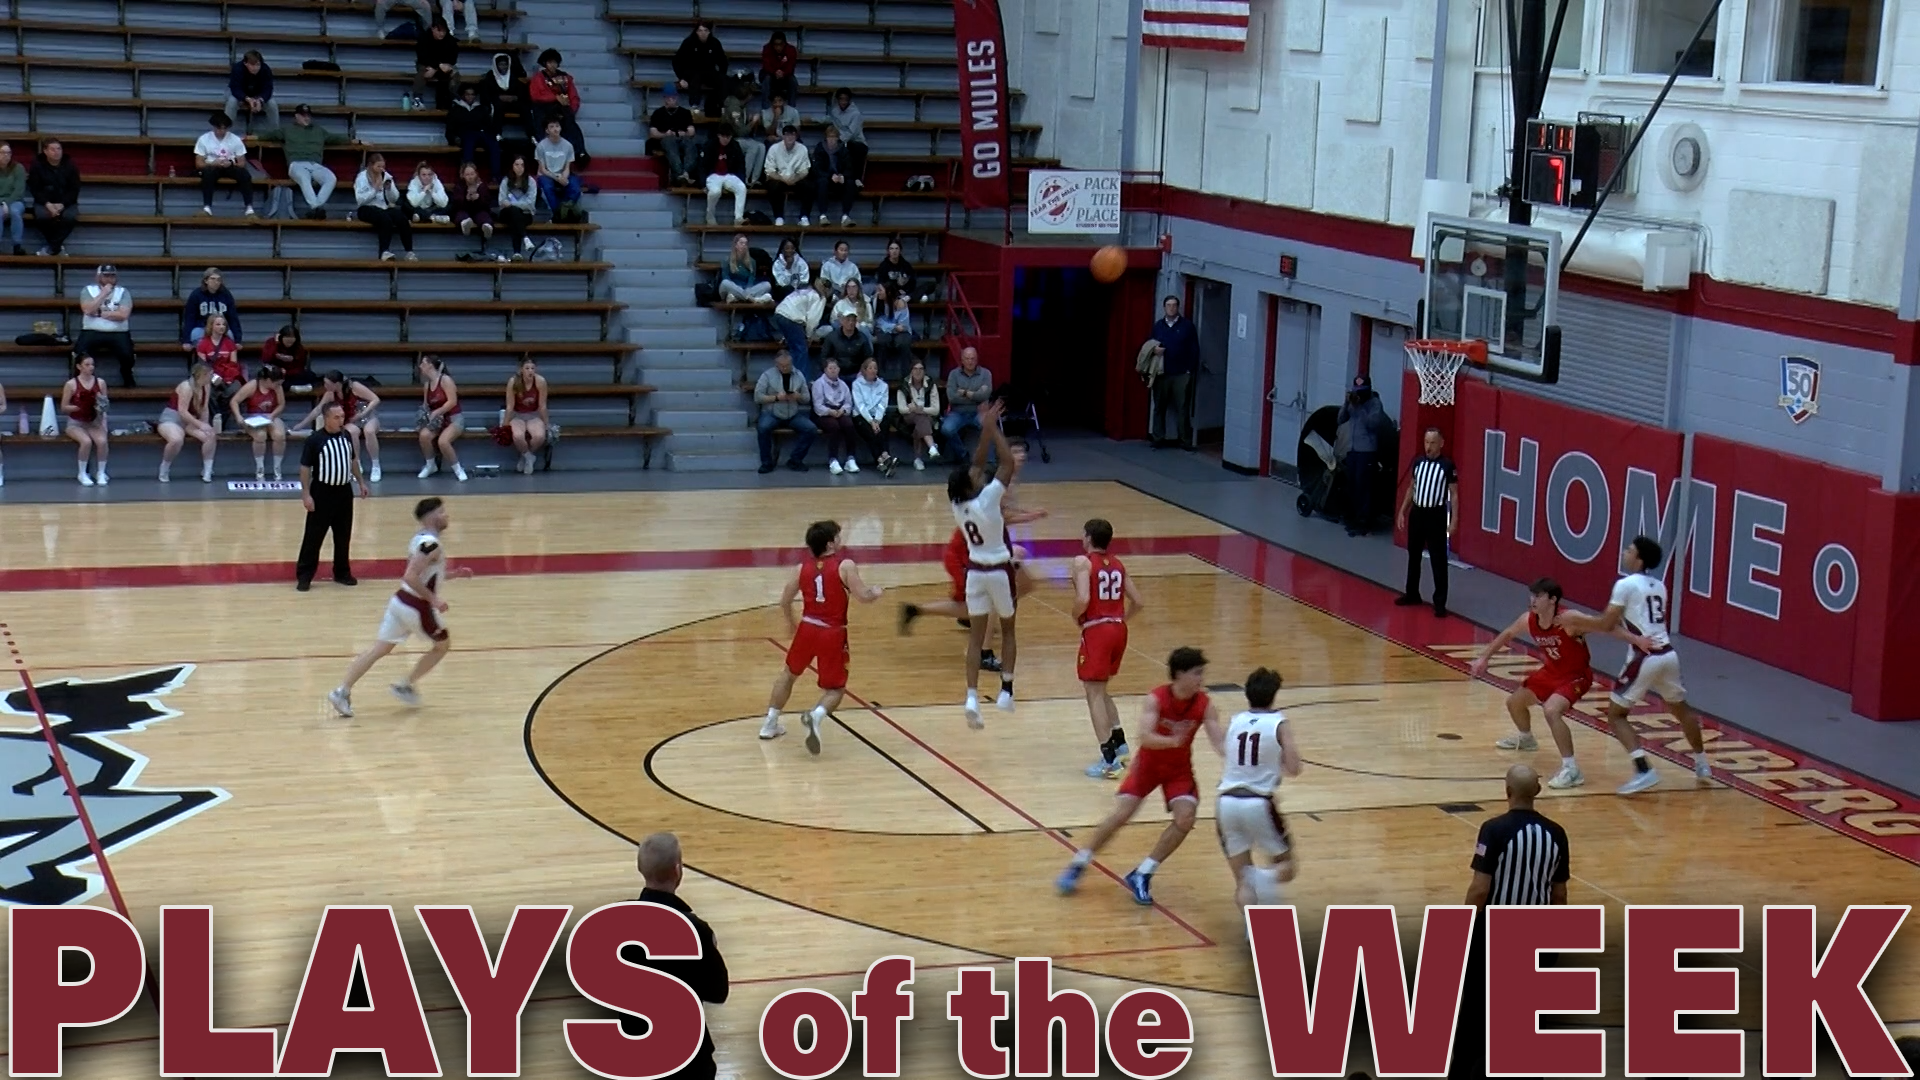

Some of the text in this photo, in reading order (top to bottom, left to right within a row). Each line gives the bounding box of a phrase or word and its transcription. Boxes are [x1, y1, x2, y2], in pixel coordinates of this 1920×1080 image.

[967, 39, 1001, 178] GO MULES
[1083, 177, 1119, 190] PACK
[1549, 158, 1564, 203] 7
[1091, 193, 1119, 206] THE
[1076, 209, 1119, 222] PLACE
[199, 301, 228, 316] GAP
[1788, 370, 1811, 398] 50
[964, 520, 984, 546] 8
[1481, 429, 1788, 619] HOME
[813, 574, 826, 602] 1
[1097, 569, 1123, 601] 22
[1646, 595, 1665, 624] 13
[1236, 731, 1261, 767] 11
